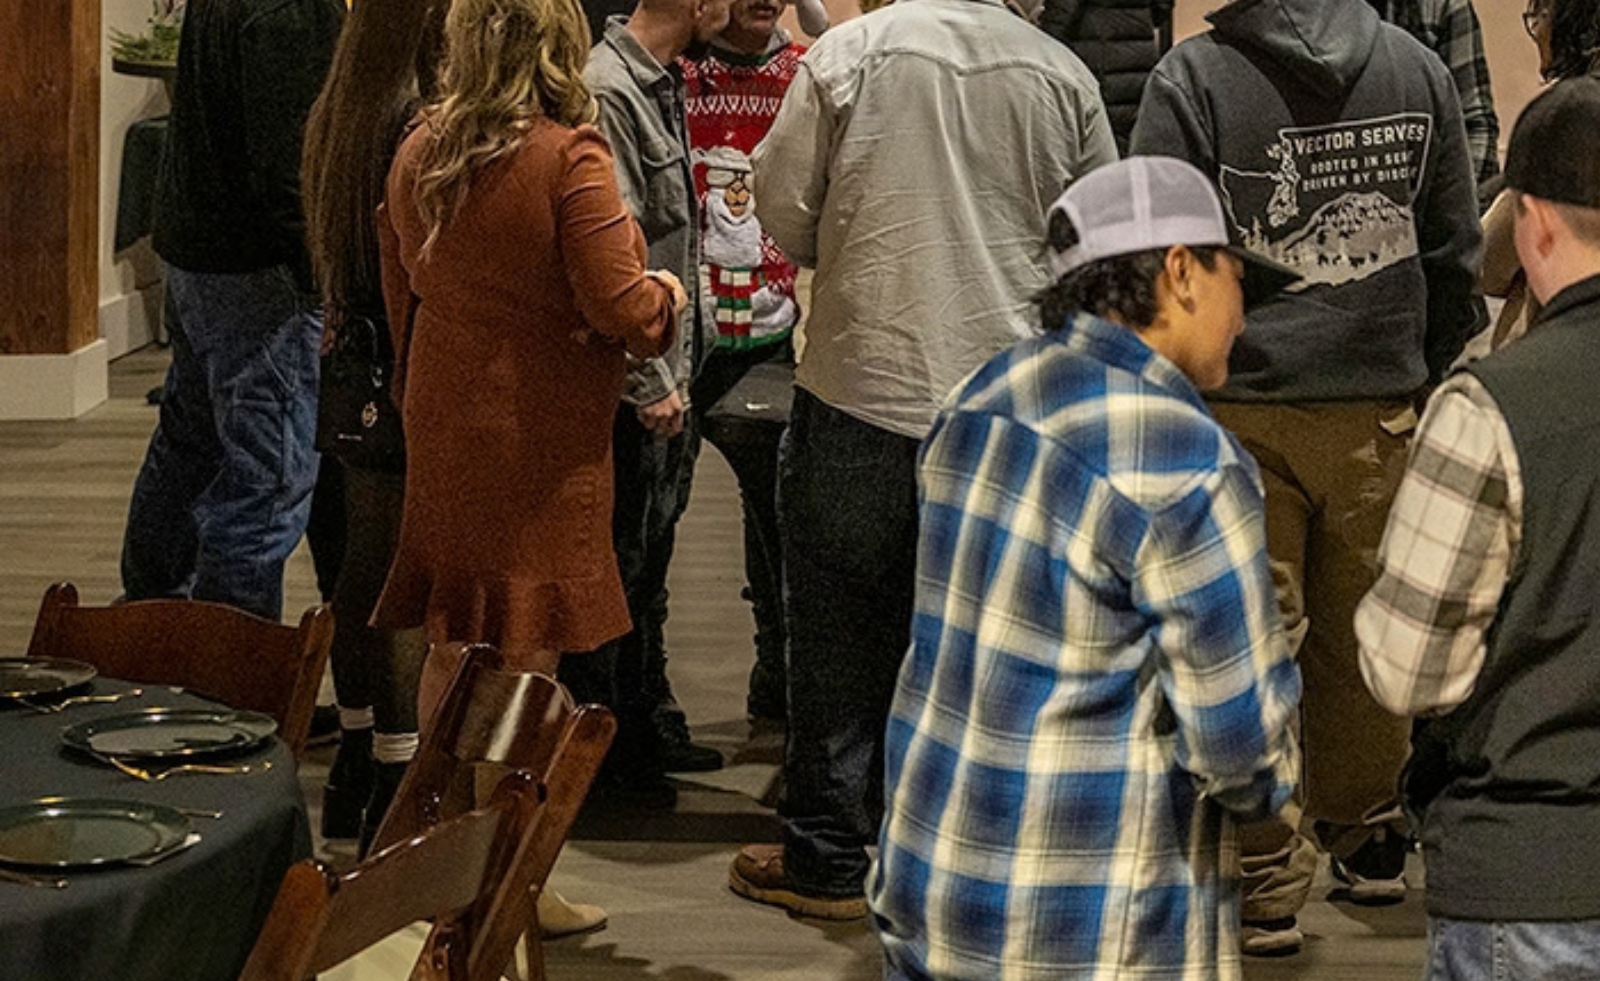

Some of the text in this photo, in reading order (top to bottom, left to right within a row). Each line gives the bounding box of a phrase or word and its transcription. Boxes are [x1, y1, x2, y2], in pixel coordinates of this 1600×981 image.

[1294, 123, 1425, 155] VECTOR SERVES
[1363, 155, 1379, 169] IN
[1352, 172, 1371, 185] BY
